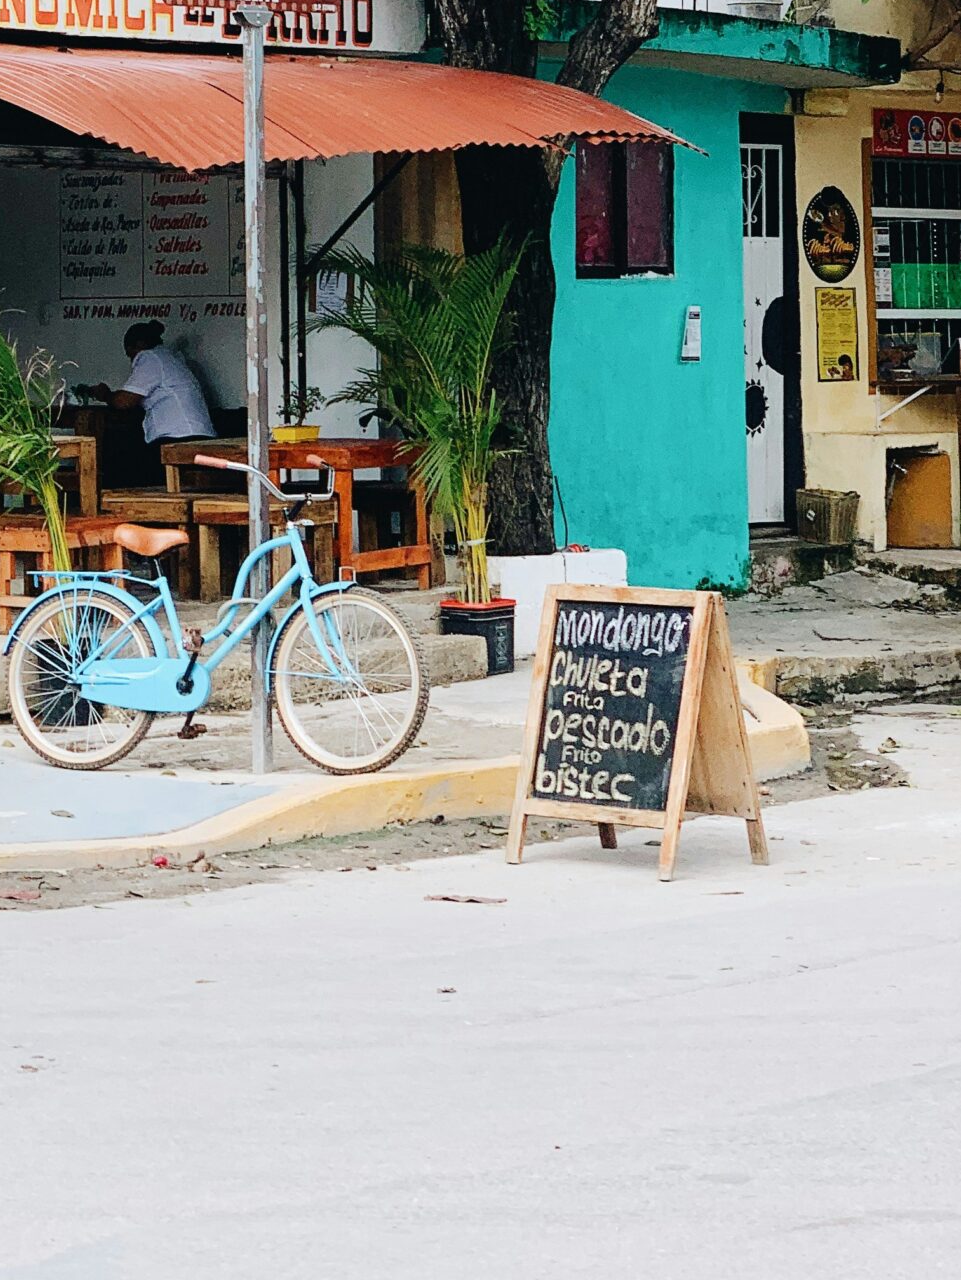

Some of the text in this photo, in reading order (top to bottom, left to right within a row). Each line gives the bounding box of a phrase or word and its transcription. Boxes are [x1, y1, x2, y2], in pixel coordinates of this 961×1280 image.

[150, 189, 209, 210] Empanadas
[150, 212, 210, 231] Quesadillas
[550, 650, 649, 699] Chuleta
[535, 753, 636, 802] bistec
